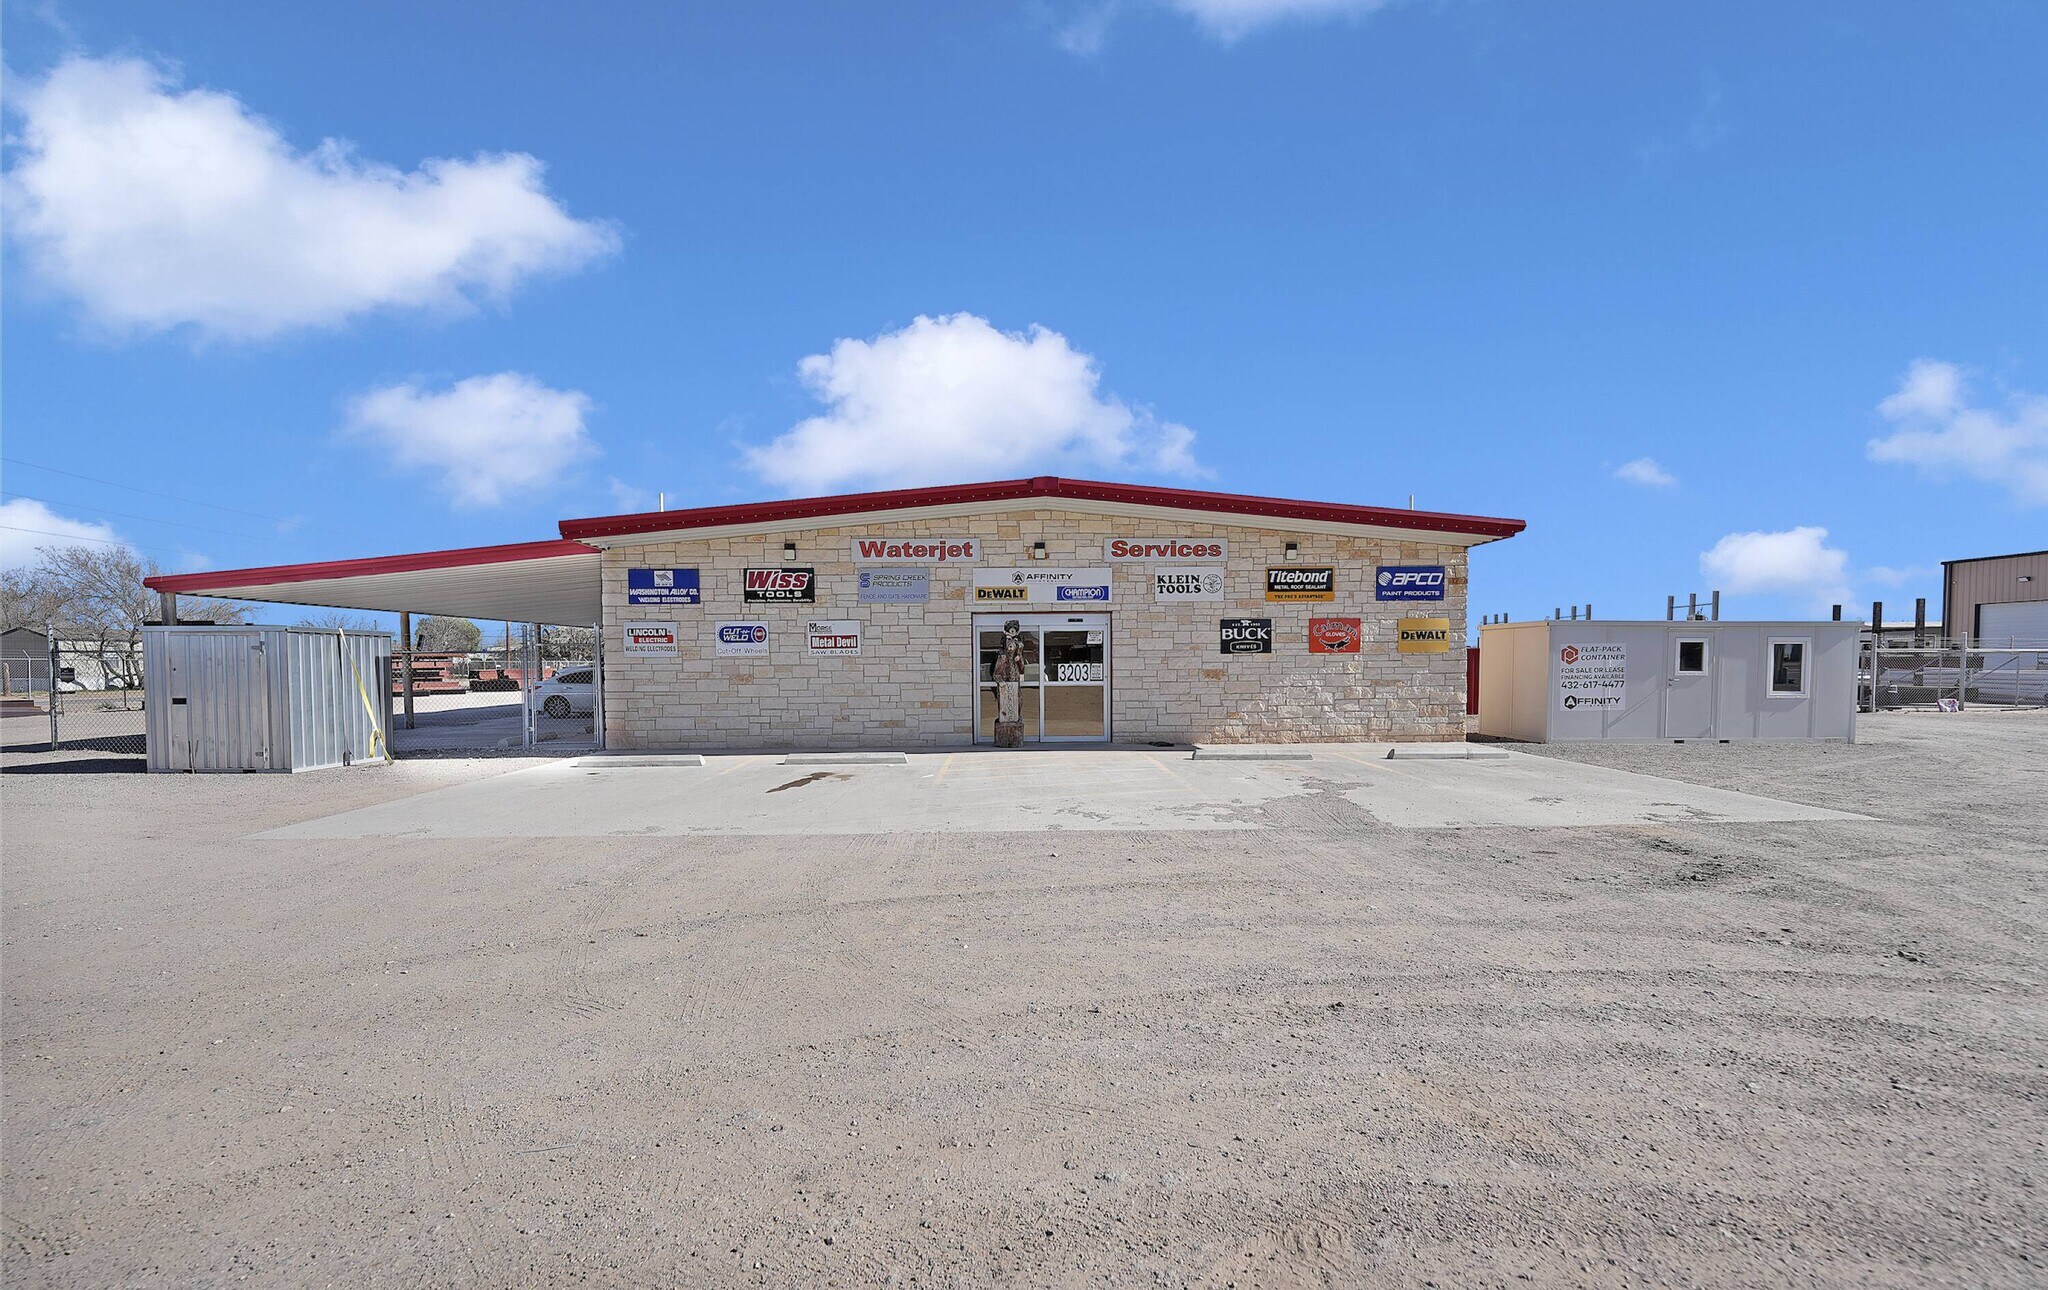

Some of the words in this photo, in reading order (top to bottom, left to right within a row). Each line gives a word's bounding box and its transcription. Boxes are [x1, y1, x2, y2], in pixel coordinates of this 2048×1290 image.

[858, 541, 973, 561] Waterjet
[1111, 540, 1222, 557] Services
[1156, 574, 1200, 584] KLEIN
[1269, 570, 1328, 582] Titebond
[1156, 584, 1202, 594] TOOLS
[1222, 628, 1269, 640] BUCK
[812, 636, 835, 648] Metal
[836, 636, 856, 648] Devil
[1059, 664, 1089, 682] 3203
[1562, 680, 1625, 689] 432-617-4477
